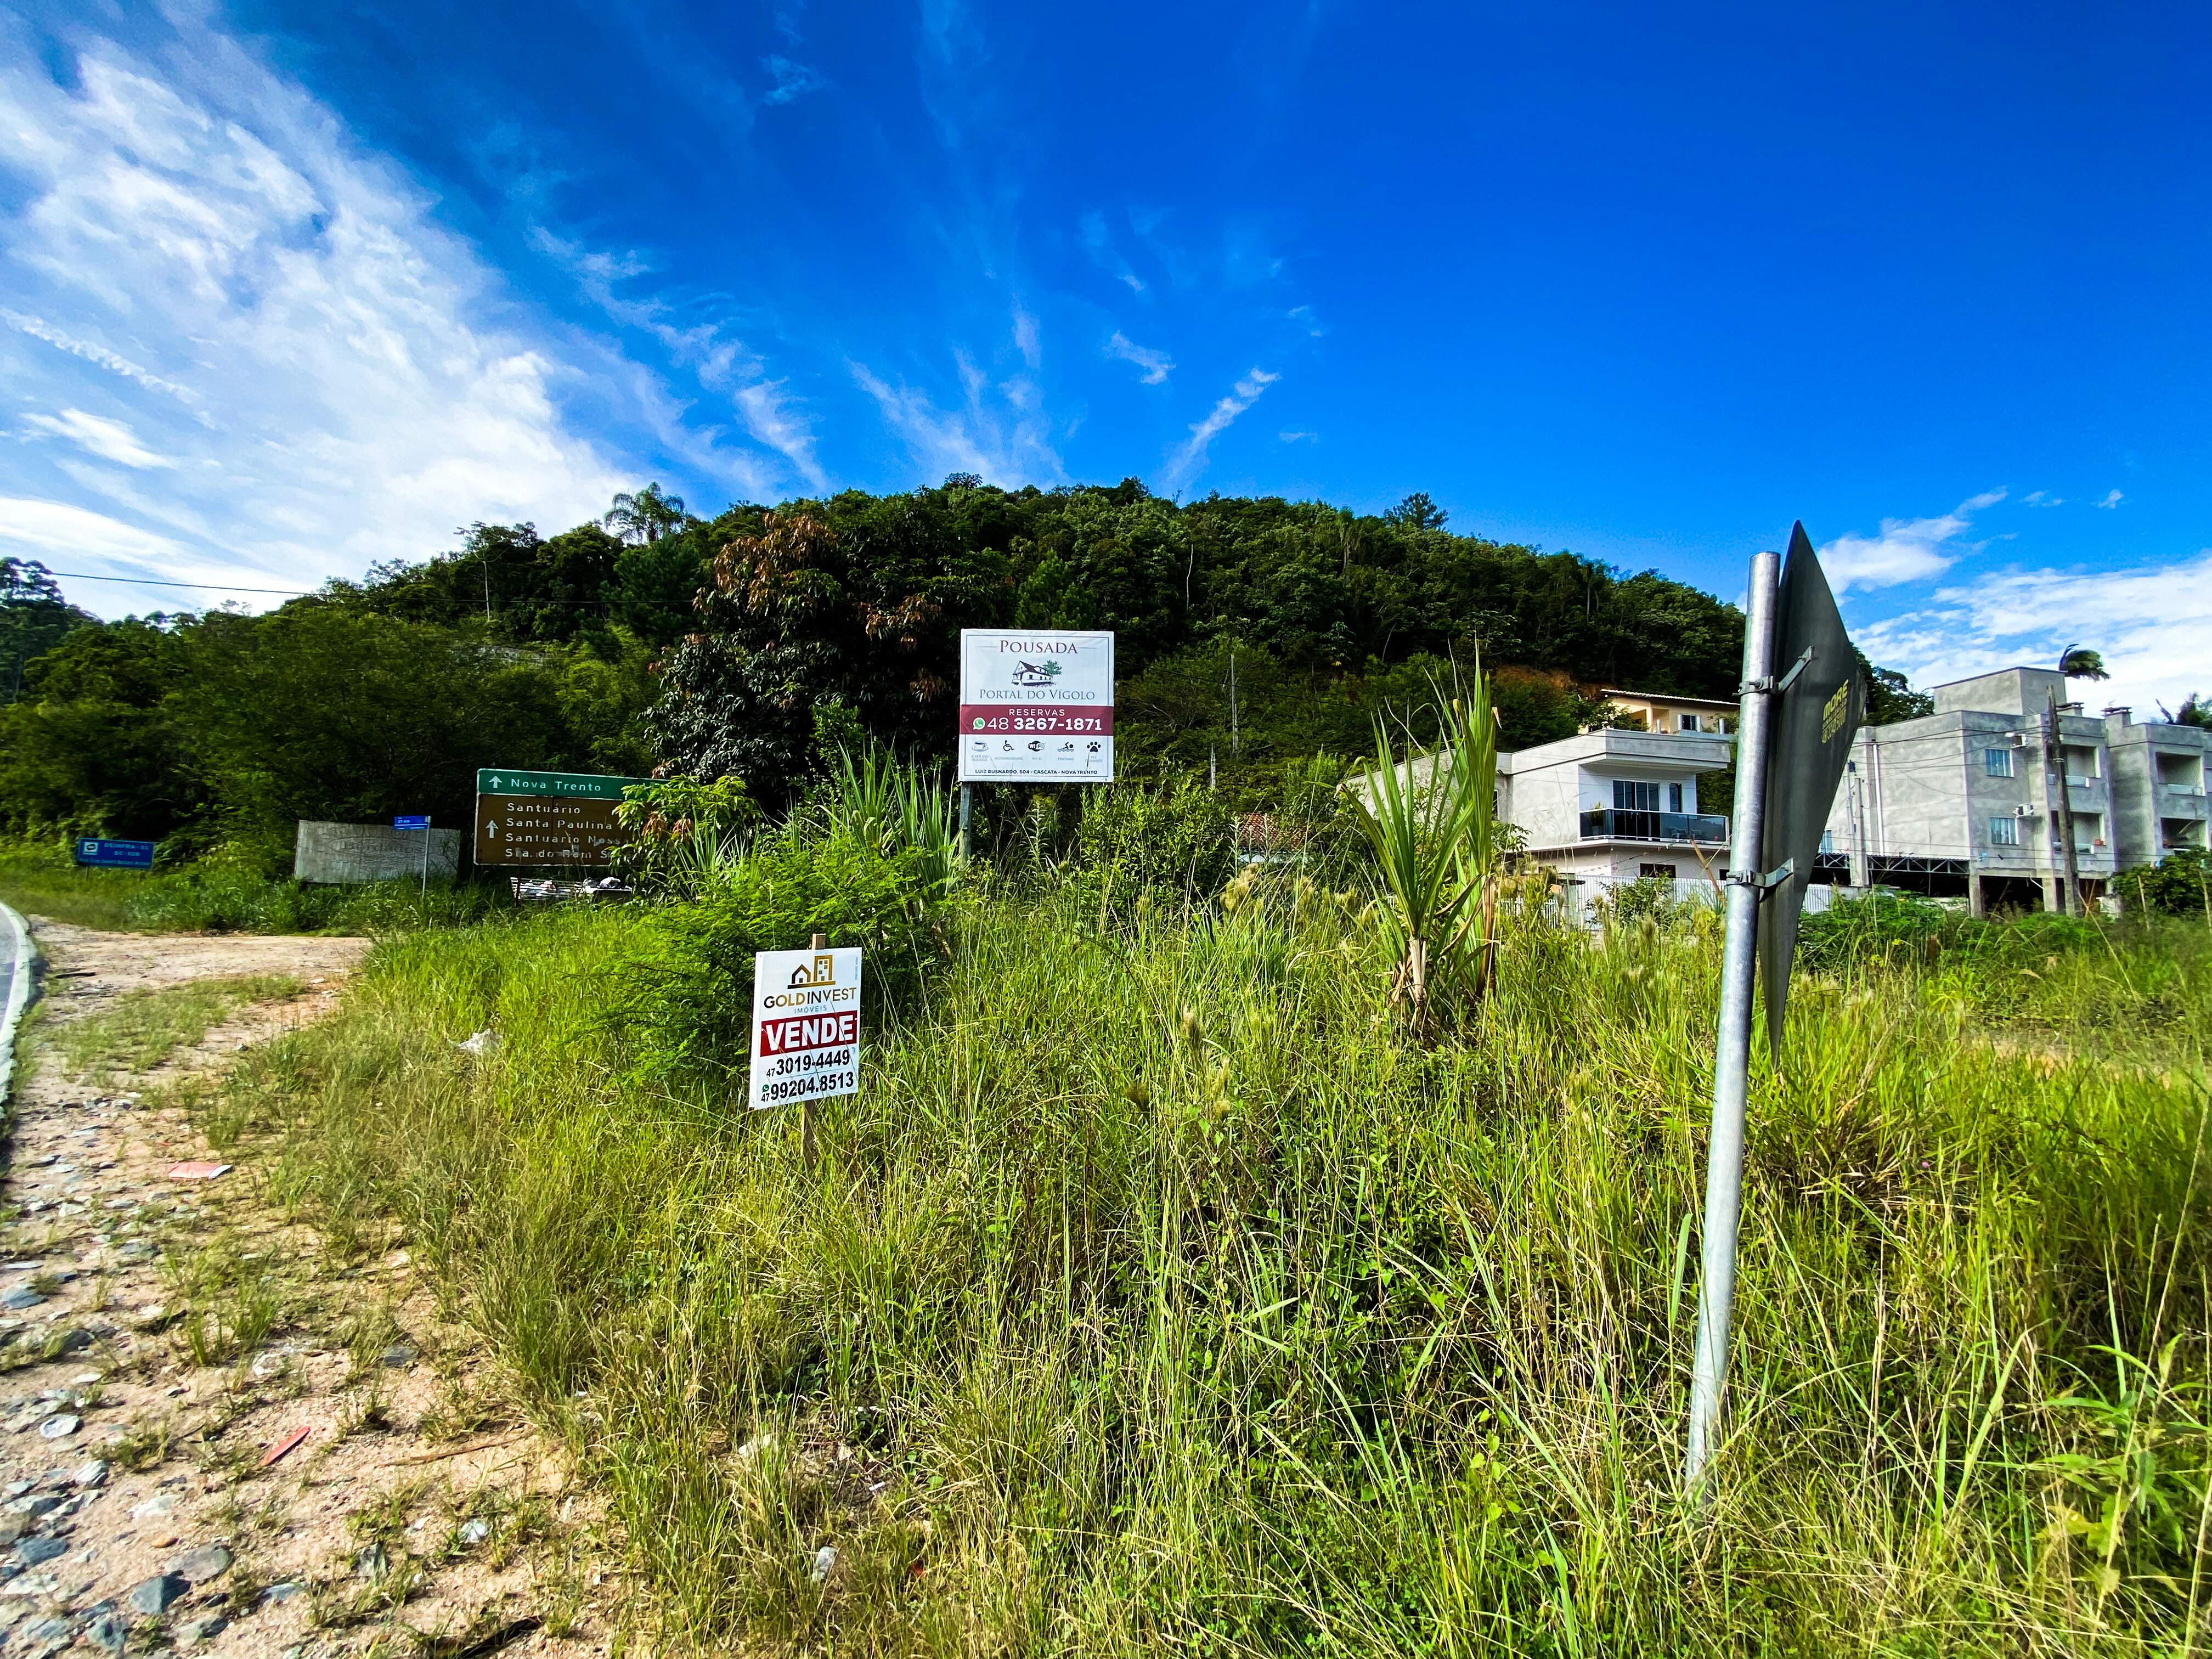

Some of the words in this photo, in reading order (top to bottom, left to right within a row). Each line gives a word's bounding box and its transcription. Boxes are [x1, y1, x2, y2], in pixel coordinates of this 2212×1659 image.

[1000, 640, 1079, 654] POUSADA
[980, 689, 1023, 699] PORTAL
[1028, 691, 1045, 699] DO
[1049, 689, 1095, 700] VÍGOLO
[988, 718, 1009, 730] 48
[1014, 718, 1102, 731] 3267-1871
[511, 778, 546, 788] Nova
[555, 781, 601, 791] Trento
[507, 803, 580, 814] Santuário
[506, 818, 549, 827] Santa
[557, 820, 612, 830] Paulina
[505, 833, 579, 843] Santuário
[538, 849, 554, 858] do
[764, 988, 856, 1009] GOLDINVEST
[794, 1005, 827, 1014] IMÓVEIS
[765, 1014, 853, 1051] VENDE
[766, 1068, 775, 1077] 47
[761, 1093, 770, 1103] 47
[771, 1071, 854, 1101] 99204.8513
